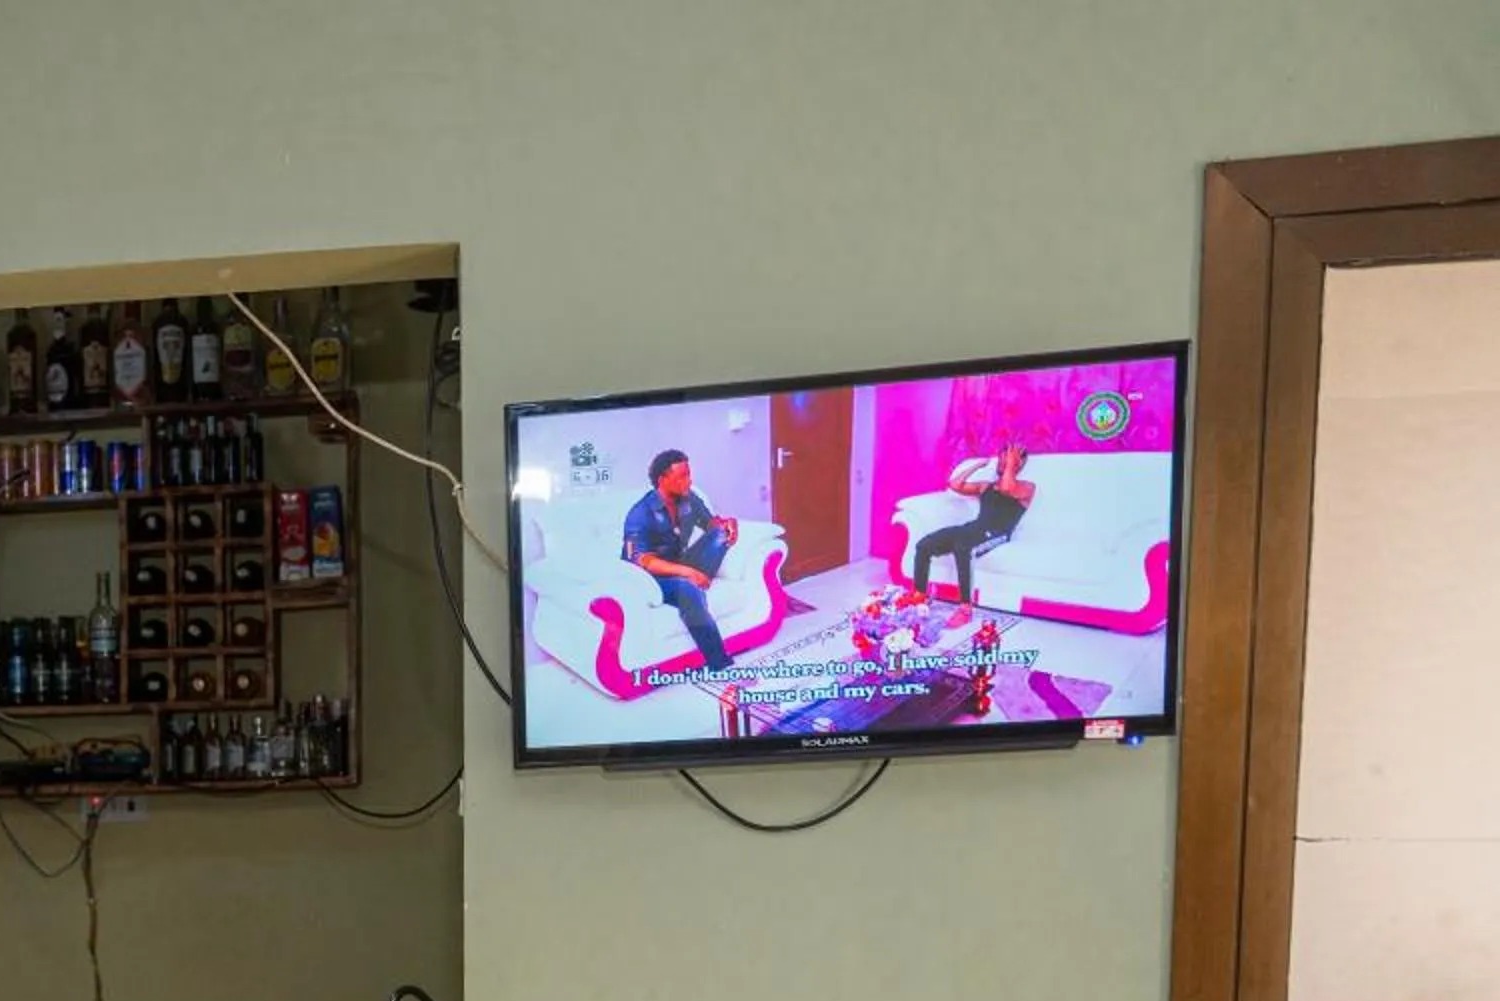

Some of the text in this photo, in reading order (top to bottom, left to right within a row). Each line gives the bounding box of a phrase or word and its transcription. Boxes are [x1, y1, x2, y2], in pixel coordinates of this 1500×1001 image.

[632, 648, 1040, 687] I don't know where to go, I have sold my
[738, 681, 930, 703] house and my cars.
